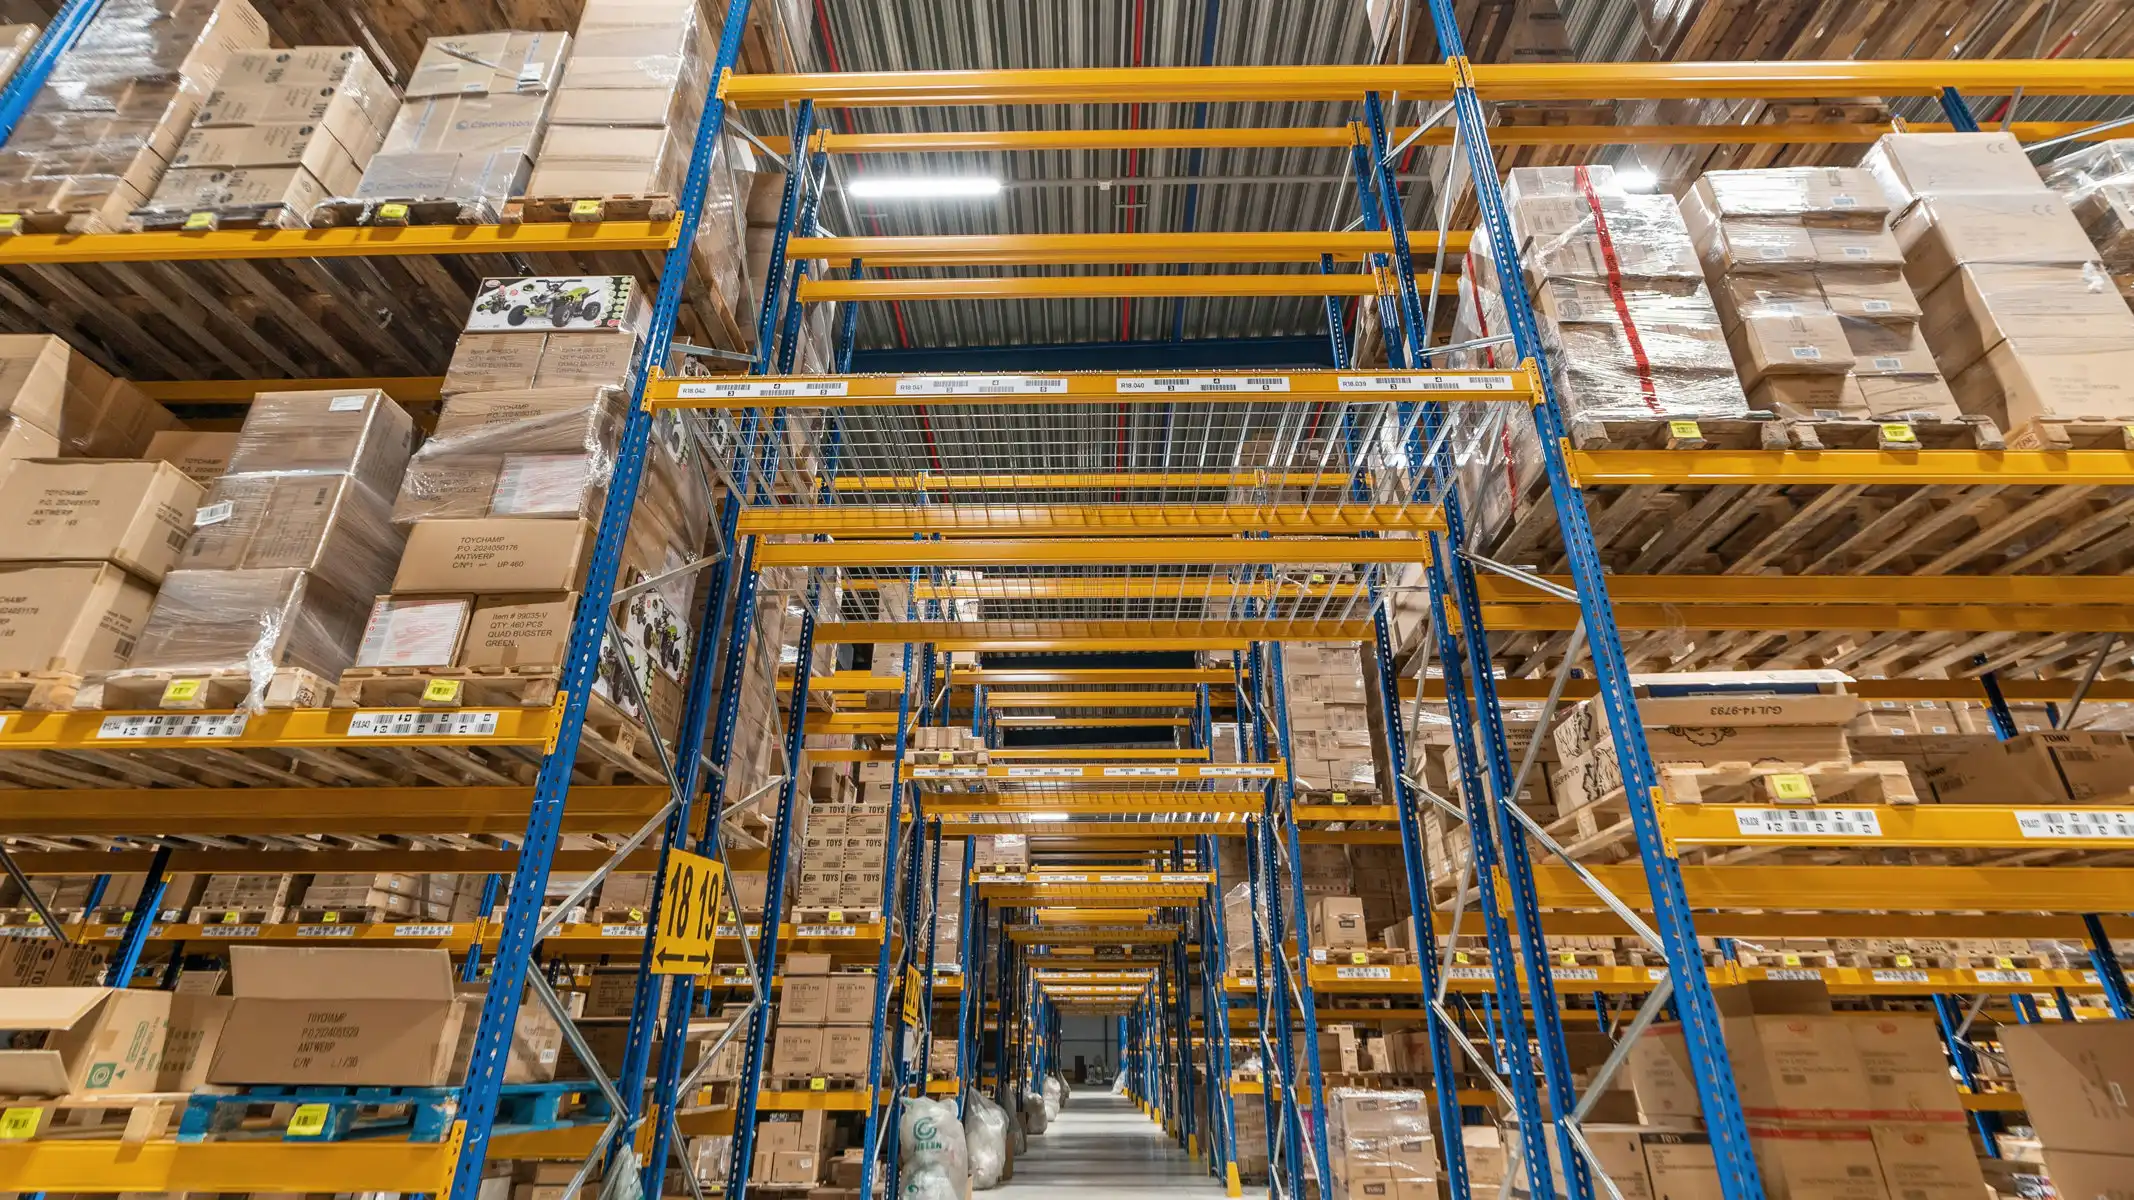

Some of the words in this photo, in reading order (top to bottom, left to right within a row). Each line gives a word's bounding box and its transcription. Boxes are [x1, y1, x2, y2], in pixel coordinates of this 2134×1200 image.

[1710, 706, 1782, 716] GJL14-9793
[2042, 735, 2072, 743] TOMY
[667, 863, 694, 938] 18
[697, 870, 718, 942] 19
[297, 1041, 335, 1052] ANTWERP
